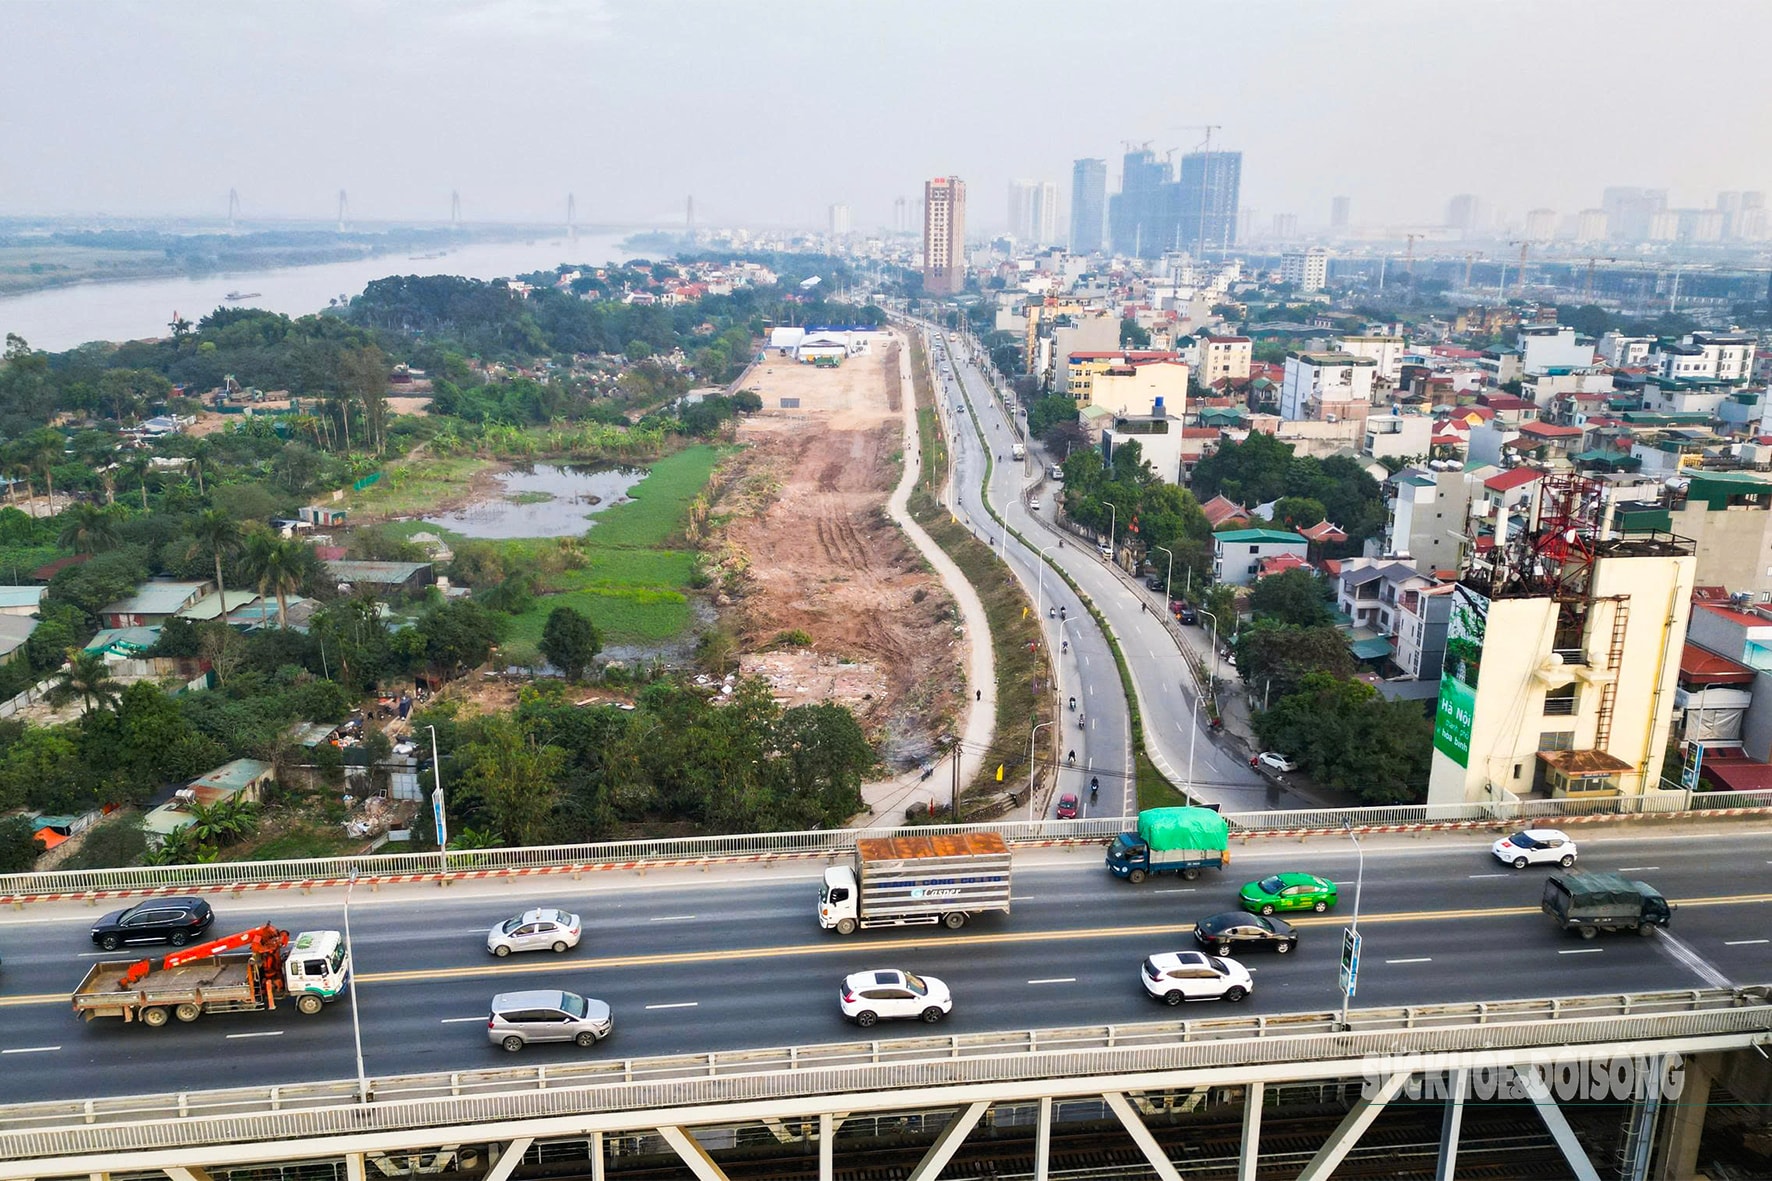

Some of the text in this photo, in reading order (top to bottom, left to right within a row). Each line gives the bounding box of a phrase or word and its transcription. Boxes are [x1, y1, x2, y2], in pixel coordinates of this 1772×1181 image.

[1441, 698, 1471, 728] Hà Nội
[1441, 728, 1453, 742] hòa
[1454, 736, 1468, 753] bình
[924, 888, 962, 899] Casper
